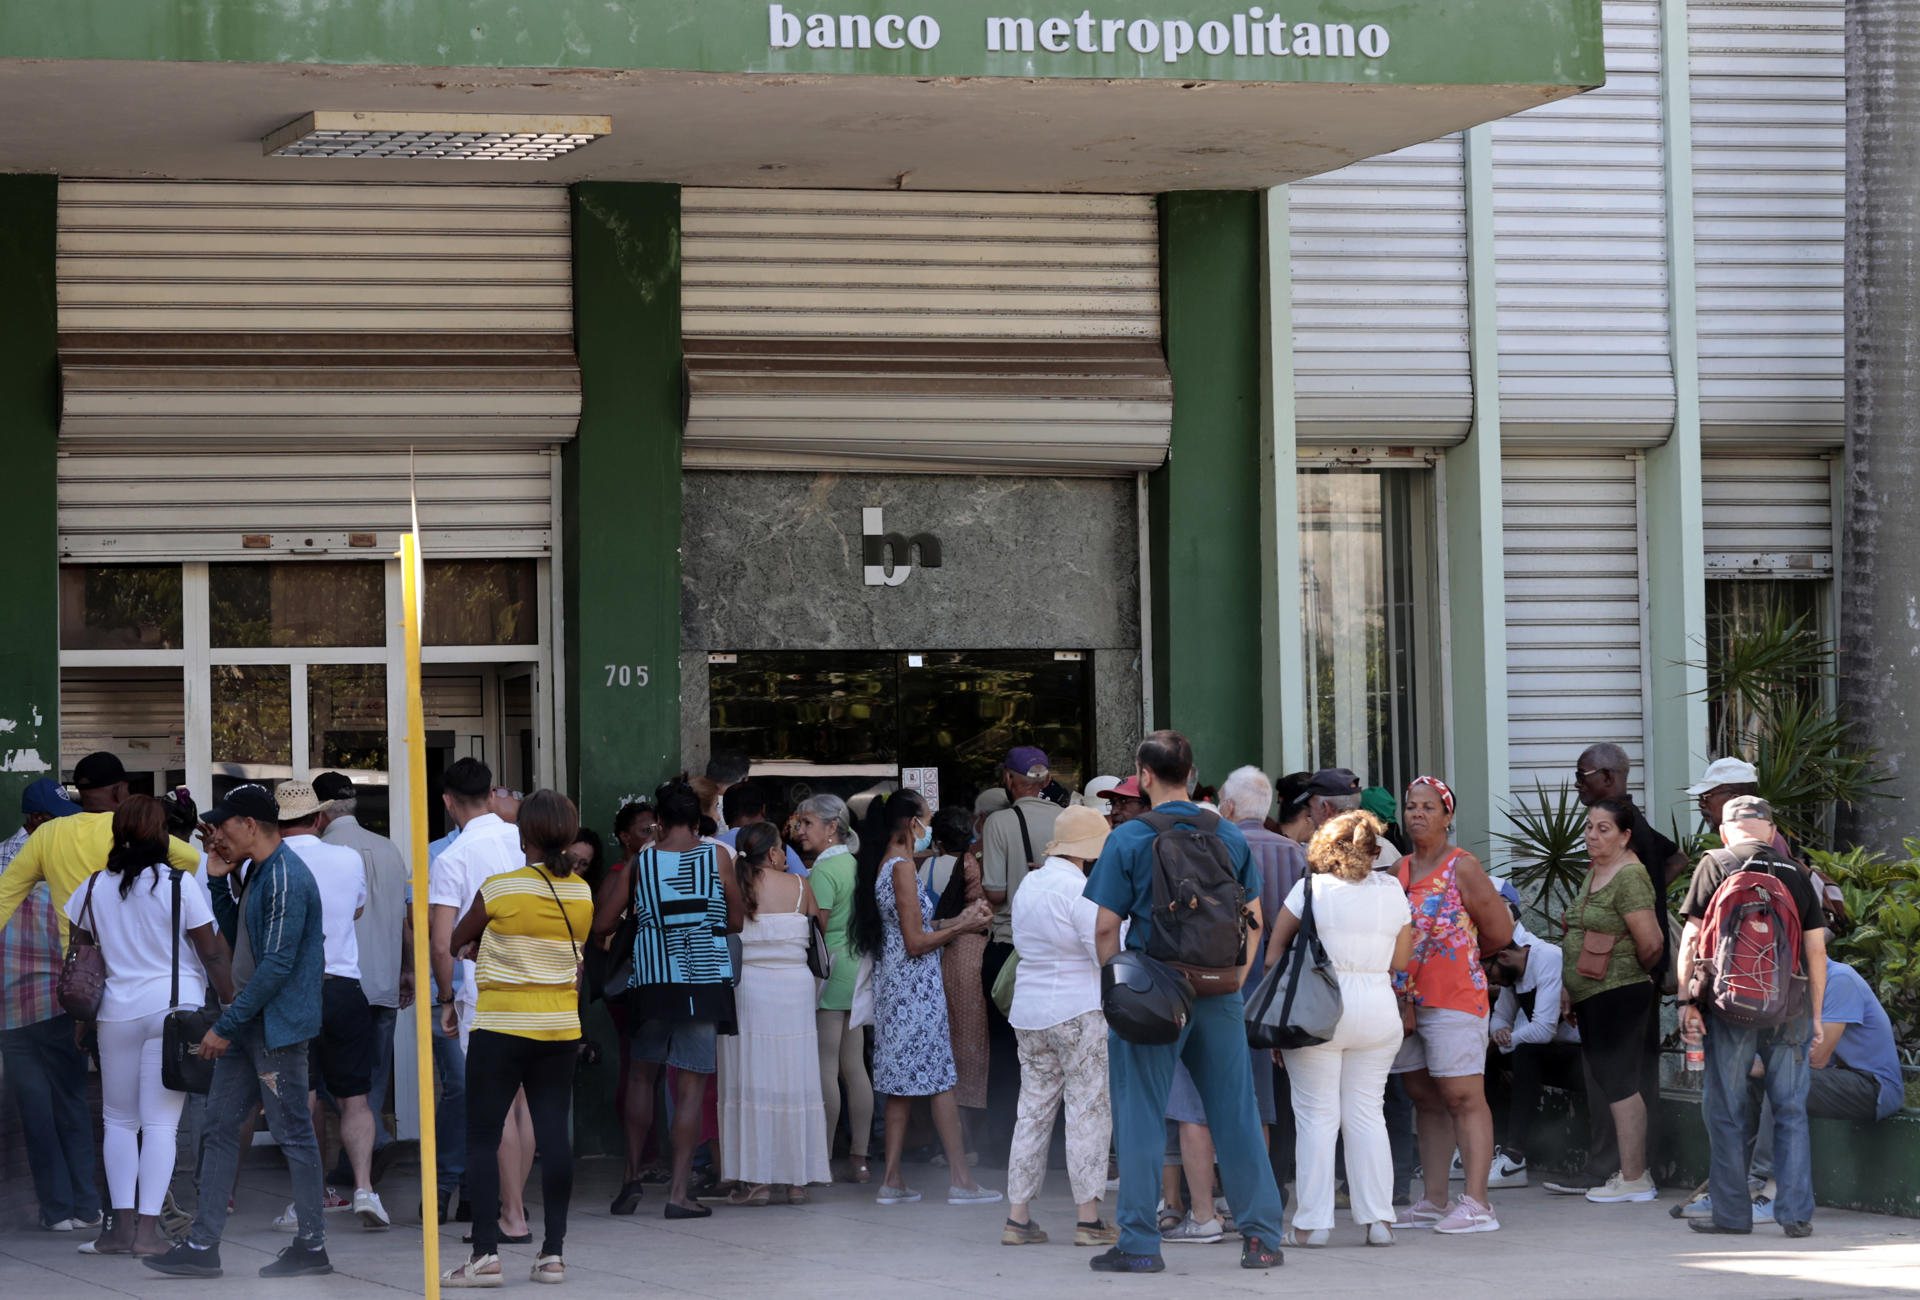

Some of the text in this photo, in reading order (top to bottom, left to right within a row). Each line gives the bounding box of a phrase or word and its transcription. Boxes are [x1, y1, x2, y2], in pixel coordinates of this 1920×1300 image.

[769, 4, 1390, 63] banco metropolitano
[604, 664, 649, 687] 705
